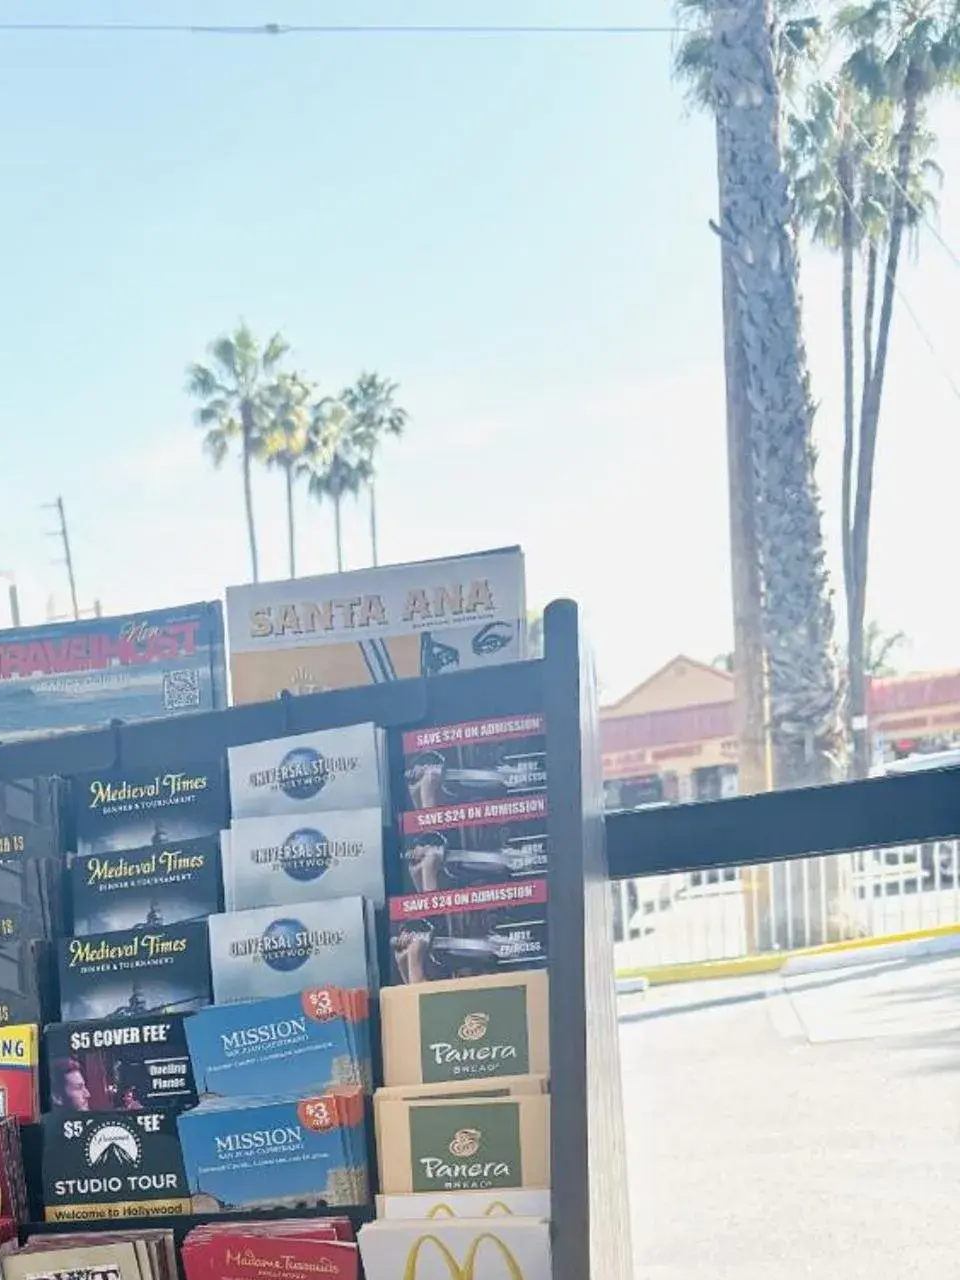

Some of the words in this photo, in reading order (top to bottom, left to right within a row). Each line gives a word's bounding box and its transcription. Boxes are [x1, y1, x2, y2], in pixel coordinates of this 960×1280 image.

[250, 594, 388, 637] SANTA
[402, 580, 496, 622] ANA
[90, 777, 159, 807] Medieval
[162, 772, 207, 795] Times
[417, 814, 443, 827] SAVE
[444, 811, 466, 825] $24
[468, 809, 482, 820] ON
[483, 799, 545, 818] ADMISSION
[71, 1032, 90, 1050] $5
[93, 1028, 140, 1046] COVER
[143, 1024, 171, 1043] FEE
[220, 1017, 307, 1050] MISSION
[429, 1042, 518, 1064] Panera
[55, 1176, 122, 1196] STUDIO
[127, 1173, 178, 1191] TOUR
[55, 1205, 106, 1220] Welcome
[107, 1206, 120, 1218] to
[123, 1203, 183, 1217] Hollywood
[226, 1250, 281, 1270] Madame
[283, 1254, 339, 1275] Tussauds
